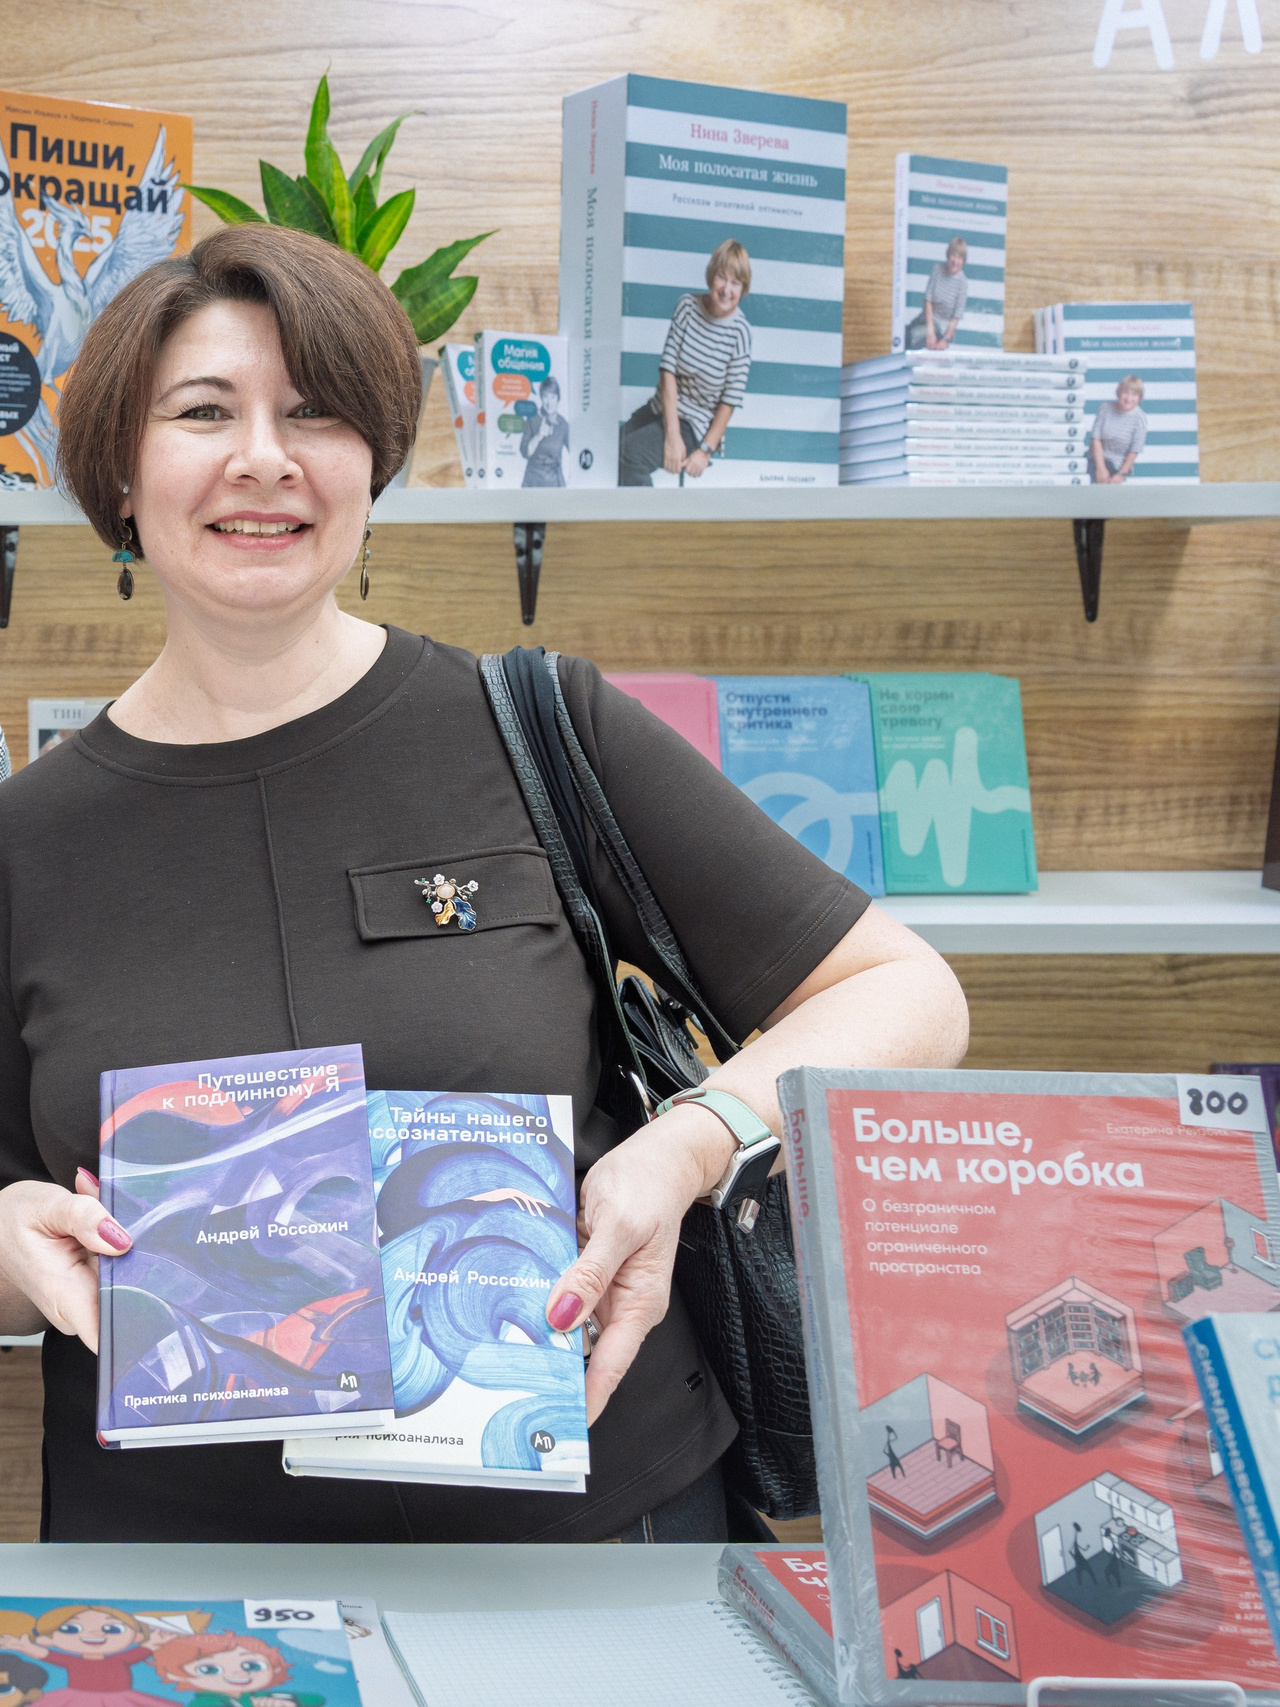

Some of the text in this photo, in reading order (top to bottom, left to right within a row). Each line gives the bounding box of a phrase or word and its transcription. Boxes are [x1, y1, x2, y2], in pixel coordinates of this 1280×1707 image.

[690, 123, 789, 150] Нина Зверева
[10, 122, 135, 178] Пиши,
[659, 154, 818, 187] Моя полосатая жизнь
[586, 187, 597, 228] Моя
[584, 237, 595, 340] полосатая
[504, 344, 538, 358] Магия
[498, 356, 545, 372] общения
[582, 347, 592, 412] жизнь
[726, 692, 791, 705] Отпусти
[879, 690, 954, 704] Не корми
[726, 706, 828, 719] внутреннего
[880, 704, 920, 714] свою
[727, 719, 792, 732] критика
[881, 716, 942, 729] тревогу
[198, 1064, 338, 1091] Путешествие
[162, 1076, 339, 1110] к подлинному Я
[1187, 1088, 1248, 1116] 800
[389, 1106, 548, 1128] Тайны нашего
[369, 1127, 548, 1145] ссознательного
[852, 1107, 1033, 1154] Больше,
[1105, 1122, 1173, 1136] Екатерина
[855, 1150, 1145, 1195] чем коробка
[862, 1198, 996, 1217] О безграничном
[196, 1219, 349, 1245] Андрей Россохин
[865, 1221, 959, 1235] потенциале
[866, 1241, 988, 1257] ограниченного
[393, 1267, 551, 1289] Андрей Россохин
[869, 1261, 982, 1277] пространства
[124, 1386, 289, 1408] Практика психоанализа
[253, 1607, 315, 1622] 950
